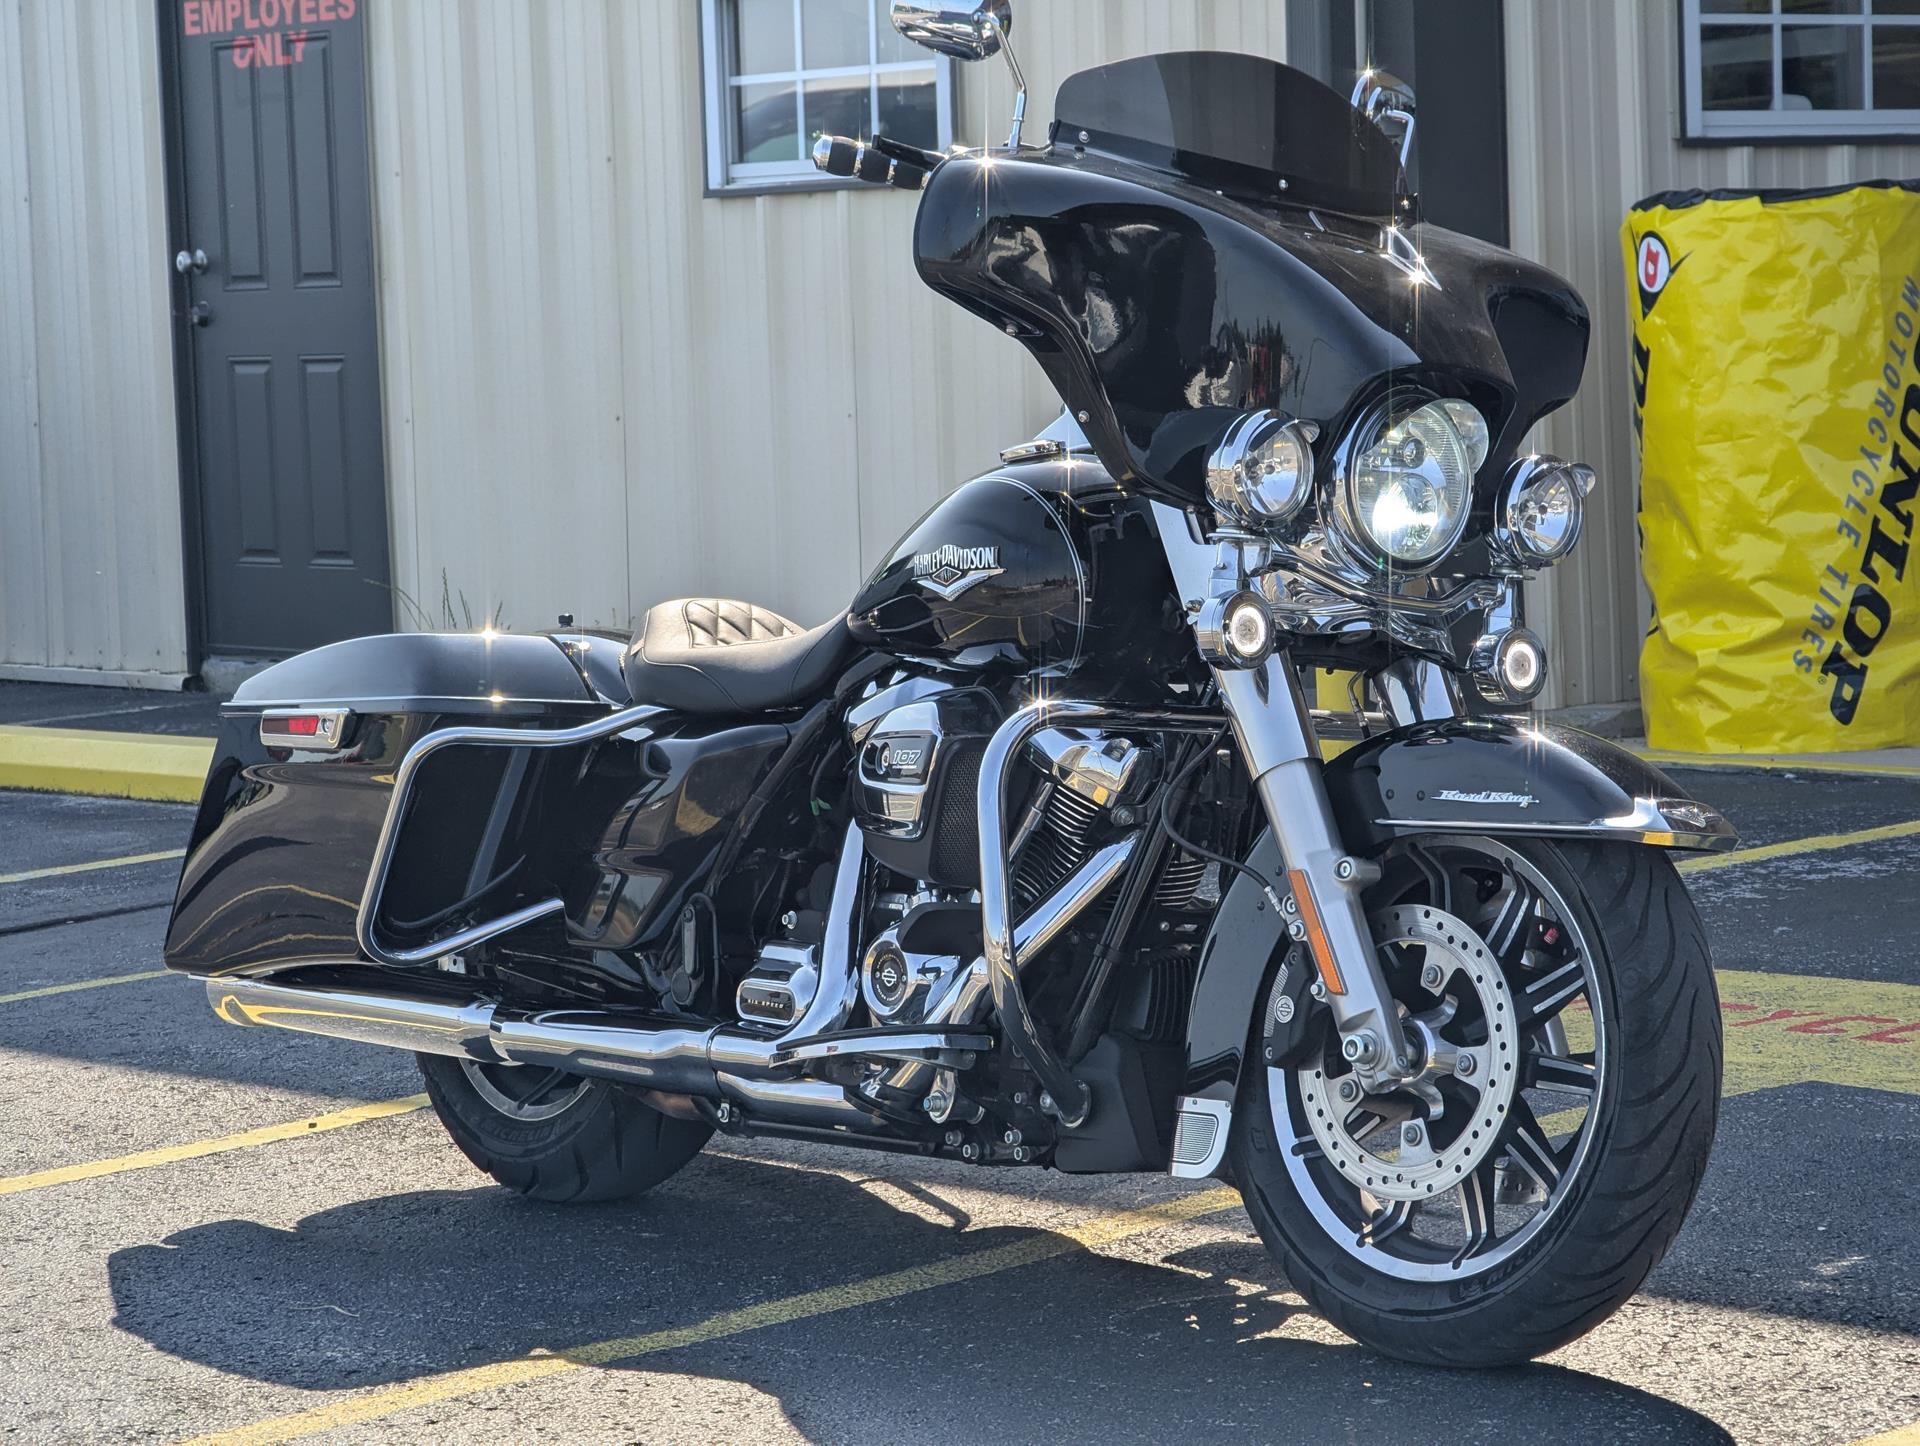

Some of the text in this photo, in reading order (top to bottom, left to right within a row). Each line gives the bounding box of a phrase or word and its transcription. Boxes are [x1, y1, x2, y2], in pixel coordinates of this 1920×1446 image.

[183, 0, 356, 36] EMPLOYEES
[233, 30, 308, 69] ONLY
[1793, 275, 1920, 674] MOTORCYCLE TIRES
[1820, 330, 1920, 726] UNLOP
[892, 749, 922, 765] 107
